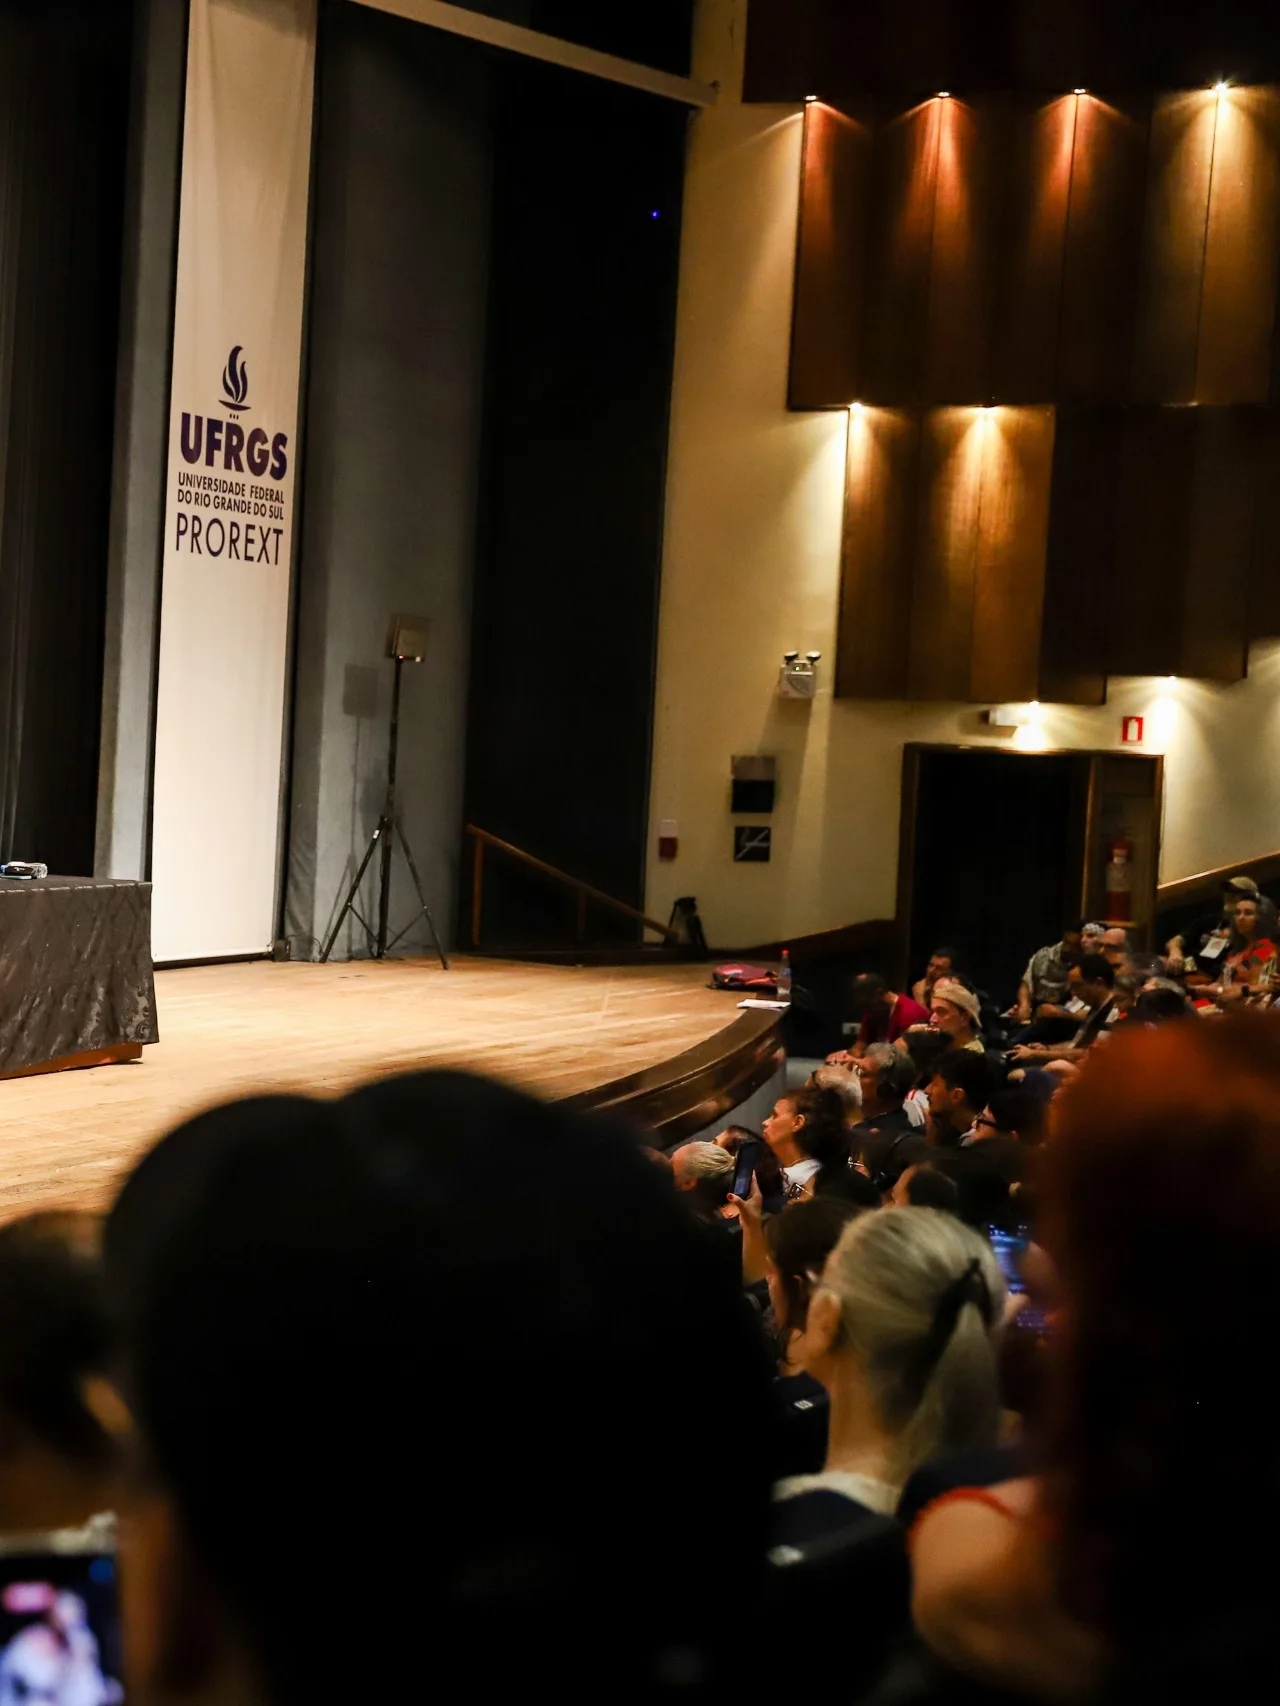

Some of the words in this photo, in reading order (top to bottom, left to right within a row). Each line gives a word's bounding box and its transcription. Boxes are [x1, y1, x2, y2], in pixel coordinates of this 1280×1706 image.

[180, 412, 287, 480] UFRGS
[177, 489, 192, 504] DO
[194, 491, 211, 508] RIO
[213, 496, 252, 515] GRANDE
[253, 503, 267, 518] DO
[268, 505, 284, 521] SUL
[178, 472, 246, 497] UNIVERSIDADE
[250, 485, 284, 504] FEDERAL
[175, 512, 284, 566] PROREXT
